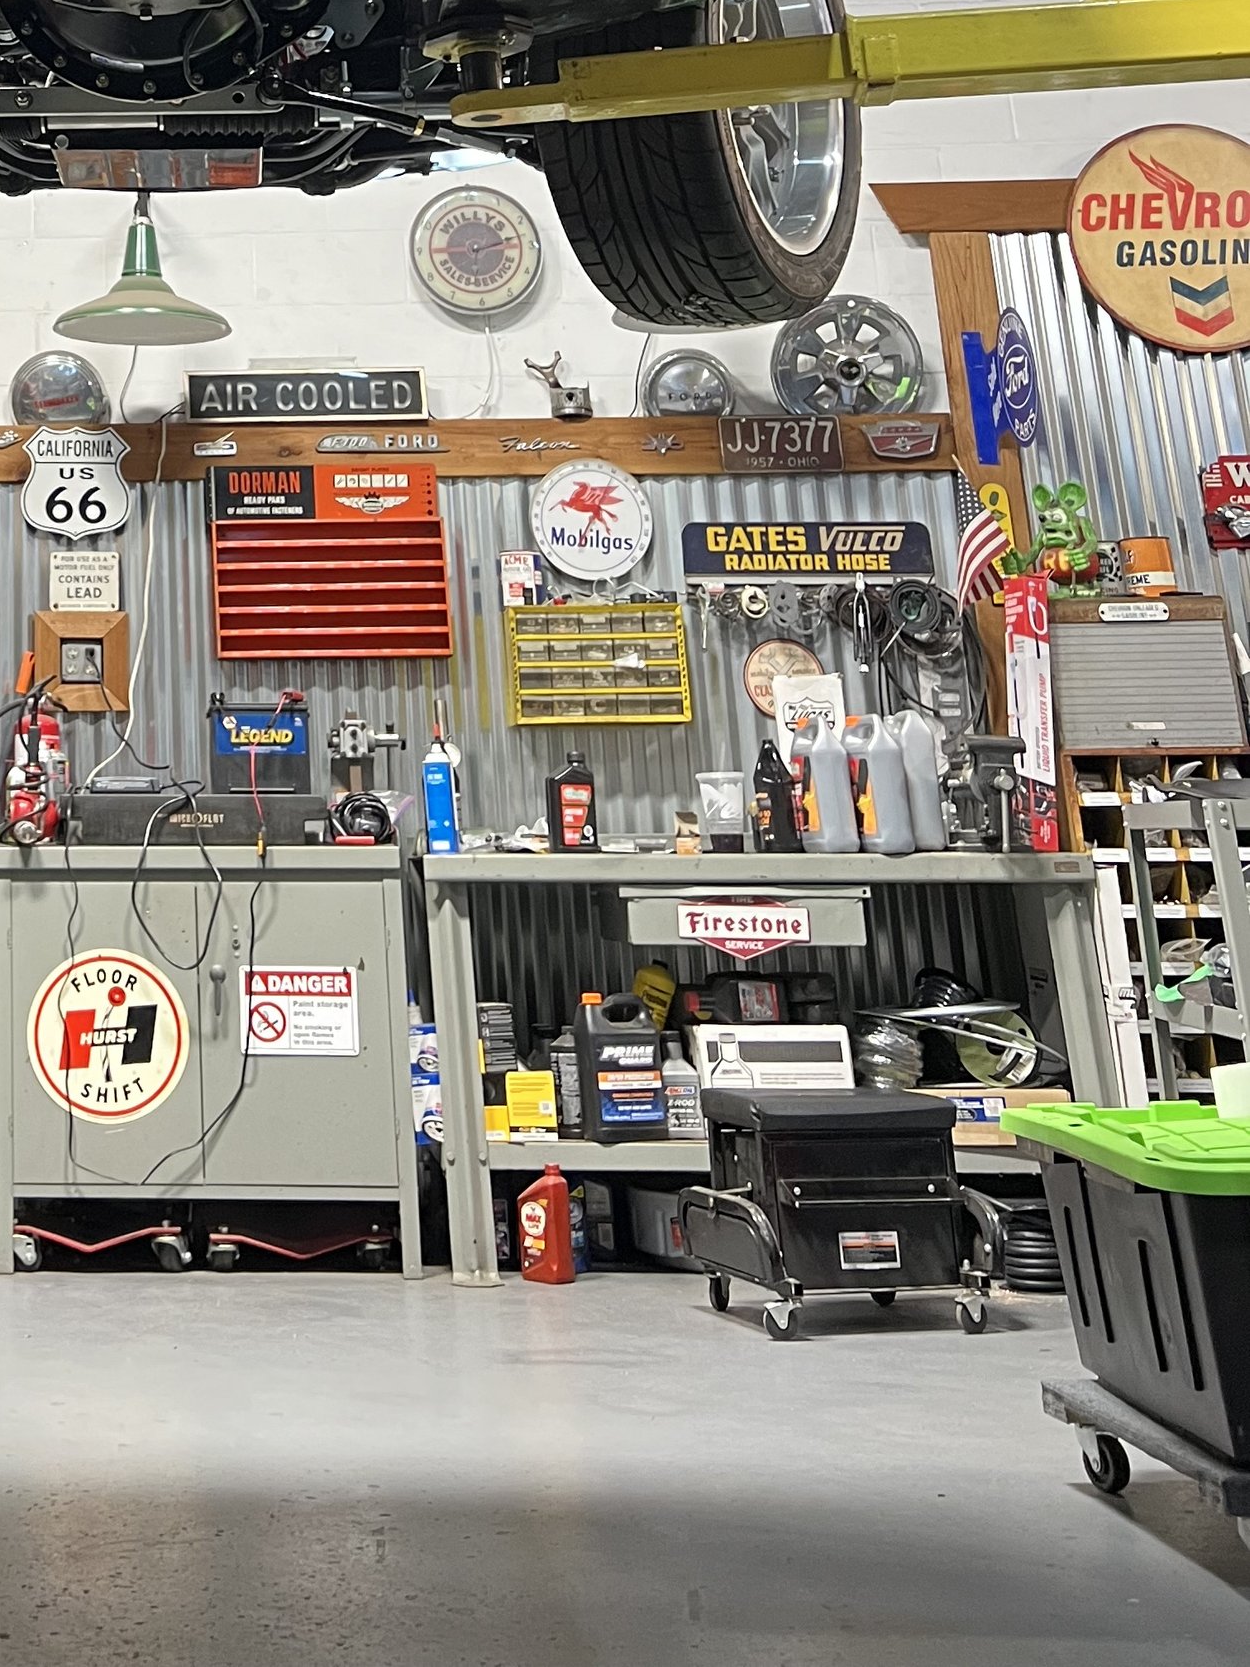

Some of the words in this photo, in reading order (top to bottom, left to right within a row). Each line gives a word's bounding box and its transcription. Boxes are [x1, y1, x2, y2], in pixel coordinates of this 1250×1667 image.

[439, 210, 506, 235] WILLYS
[1116, 238, 1250, 268] GASOLIN
[1004, 354, 1029, 398] Ford
[200, 381, 258, 411] AIR
[274, 379, 413, 411] COOLED
[667, 391, 713, 401] FORD
[1014, 408, 1036, 438] PARTS
[37, 439, 114, 458] CALIFORNIA
[383, 434, 439, 449] FORD
[499, 436, 581, 453] Falcon
[787, 457, 820, 468] OHIO
[59, 467, 95, 480] US
[228, 470, 301, 494] DORMAN
[45, 486, 107, 524] 66
[551, 526, 634, 555] Mobilgas
[705, 525, 808, 553] GATES
[818, 525, 906, 552] VULCO
[504, 554, 529, 567] ACME
[724, 553, 830, 572] RADIATOR
[836, 553, 892, 571] HOSE
[58, 574, 110, 583] CONTAINS
[66, 587, 102, 599] LEAD
[1038, 672, 1047, 699] PUMP
[1039, 700, 1049, 742] TRANSFER
[230, 728, 293, 744] LEGEND
[685, 911, 802, 935] Firestone
[724, 940, 765, 951] SERVICE
[70, 968, 138, 993] FLOOR
[267, 974, 349, 993] DANGER
[317, 1001, 348, 1009] storage
[79, 1028, 138, 1046] HURST
[600, 1045, 655, 1061] PRIME
[81, 1077, 144, 1103] SHIFT
[525, 1213, 542, 1224] MAX
